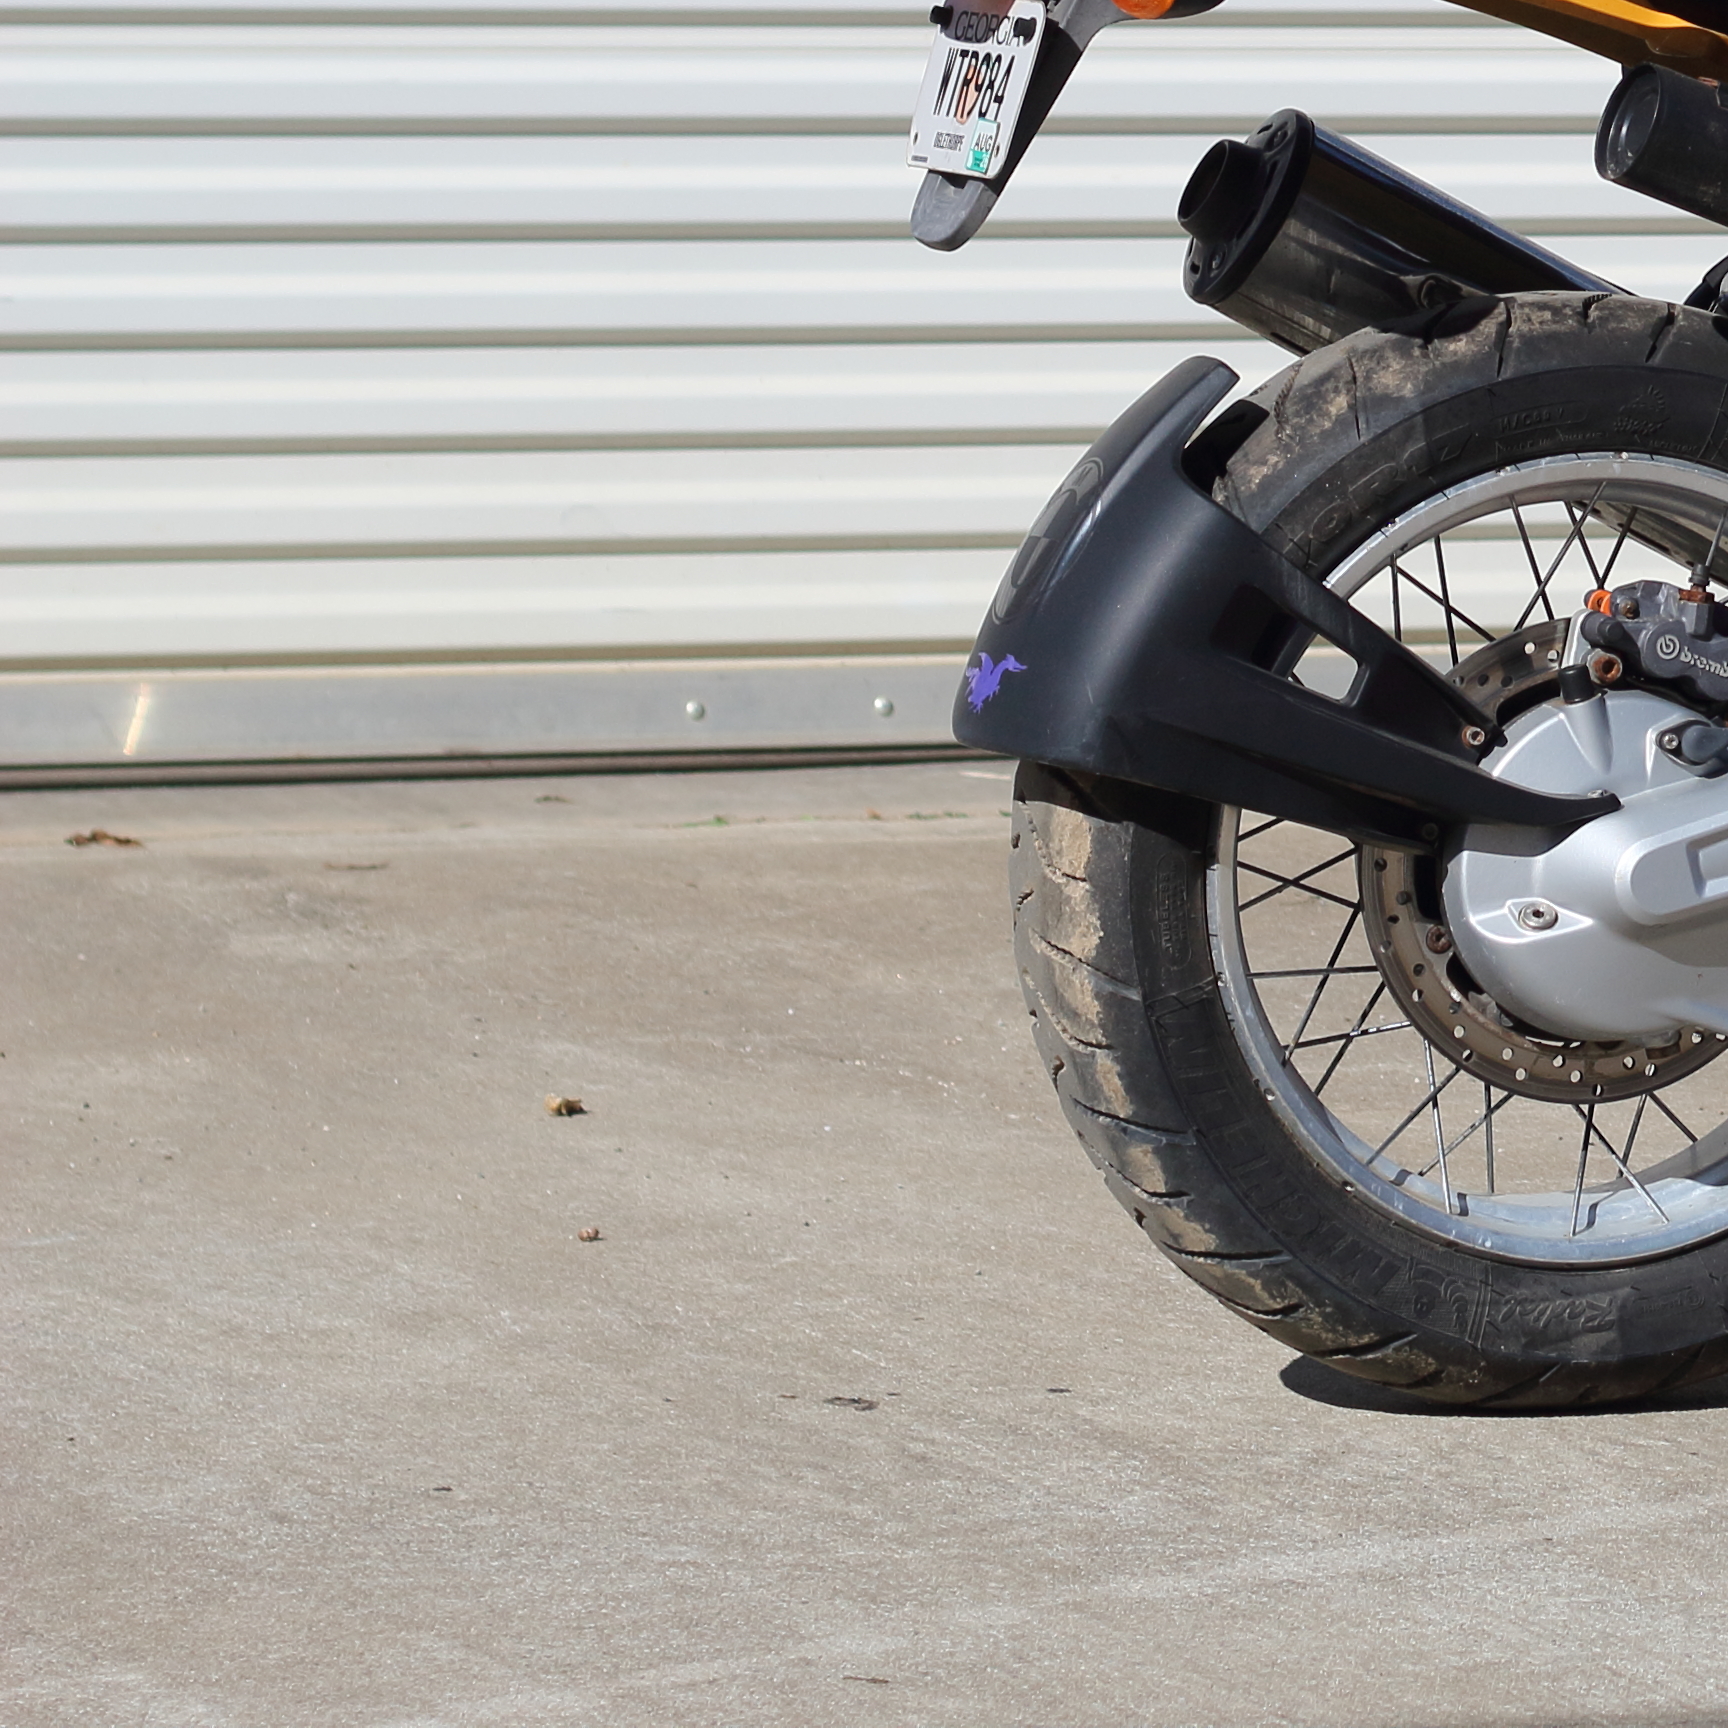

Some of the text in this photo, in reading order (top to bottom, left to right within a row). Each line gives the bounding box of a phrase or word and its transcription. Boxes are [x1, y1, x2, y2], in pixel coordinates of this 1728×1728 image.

[974, 132, 993, 152] AUG
[1153, 1001, 1402, 1296] MICHELIN
[1496, 1294, 1616, 1334] Radial
